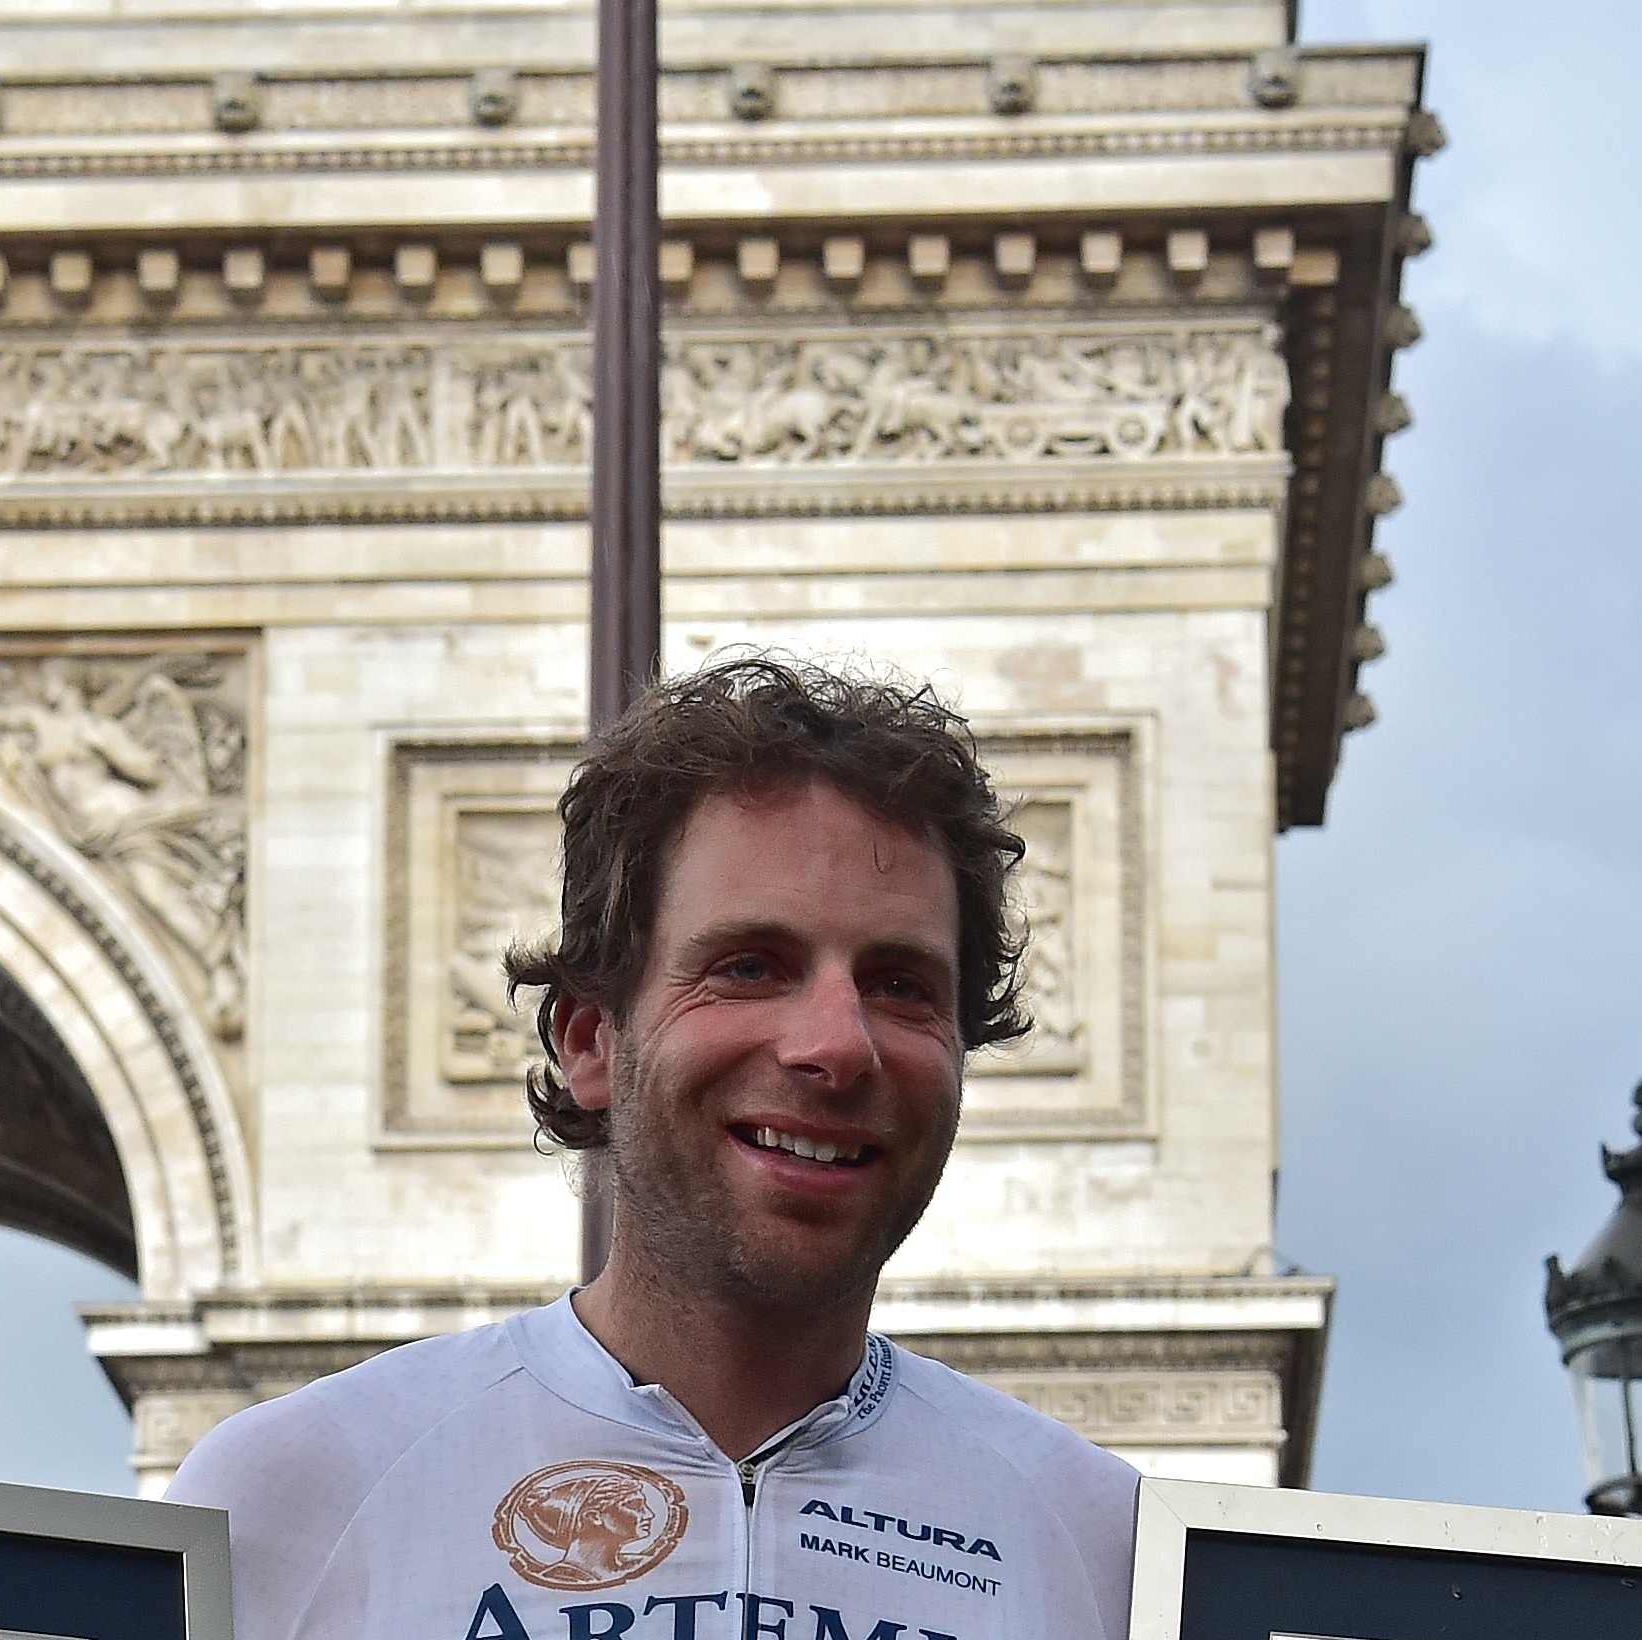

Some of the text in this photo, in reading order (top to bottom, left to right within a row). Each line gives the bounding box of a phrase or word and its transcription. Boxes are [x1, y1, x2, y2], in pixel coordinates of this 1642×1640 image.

[798, 1499, 1002, 1562] ALTURA
[800, 1533, 1001, 1596] MARK BEAUMONT
